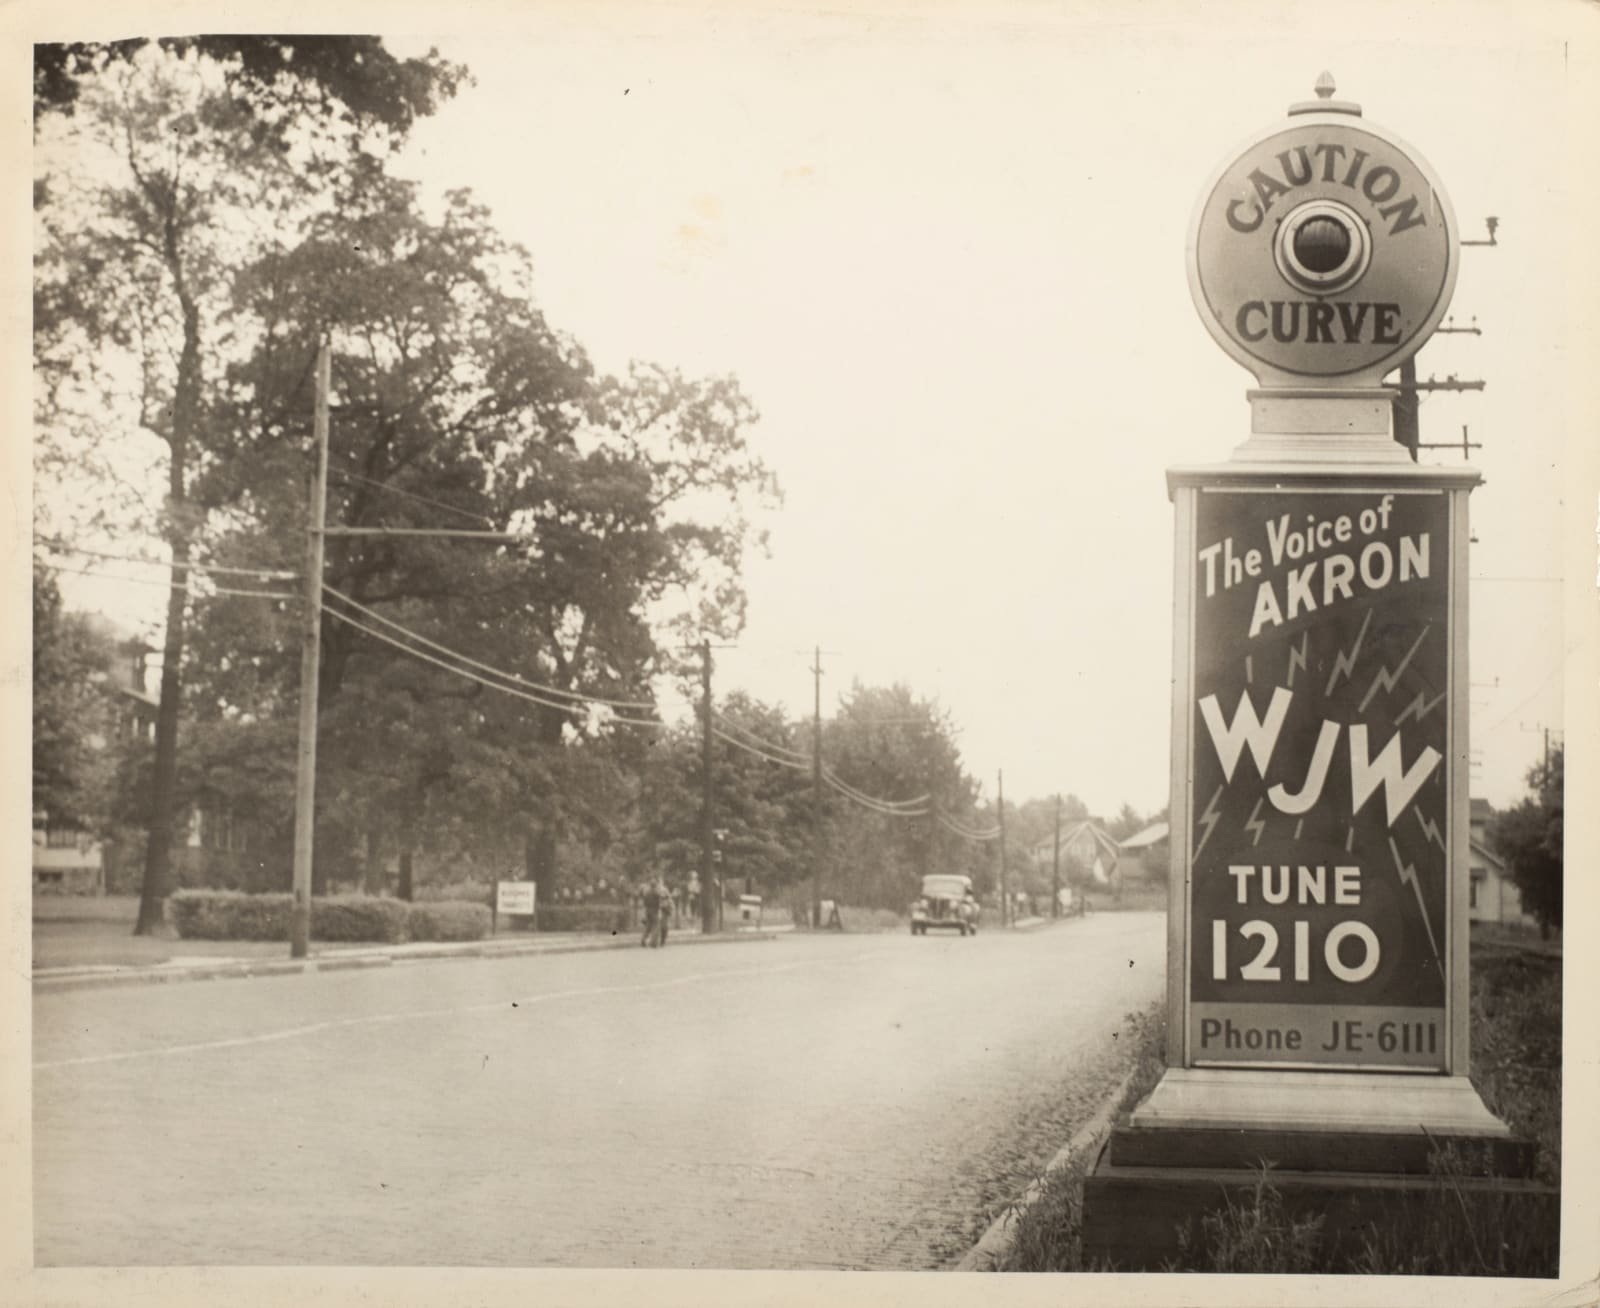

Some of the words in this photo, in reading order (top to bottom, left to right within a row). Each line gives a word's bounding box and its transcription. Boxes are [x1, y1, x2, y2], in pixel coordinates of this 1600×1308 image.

[1225, 143, 1427, 236] CAUTION
[1235, 300, 1402, 344] CURVE
[1199, 537, 1262, 597] The
[1266, 513, 1352, 566] Voice
[1359, 494, 1394, 534] of
[1248, 532, 1430, 638] AKRON
[1198, 685, 1443, 828] WJW
[1228, 865, 1361, 904] TUNE
[1212, 919, 1381, 982] 1210
[1200, 1018, 1303, 1049] Phone
[1321, 1020, 1437, 1053] JE-6111
